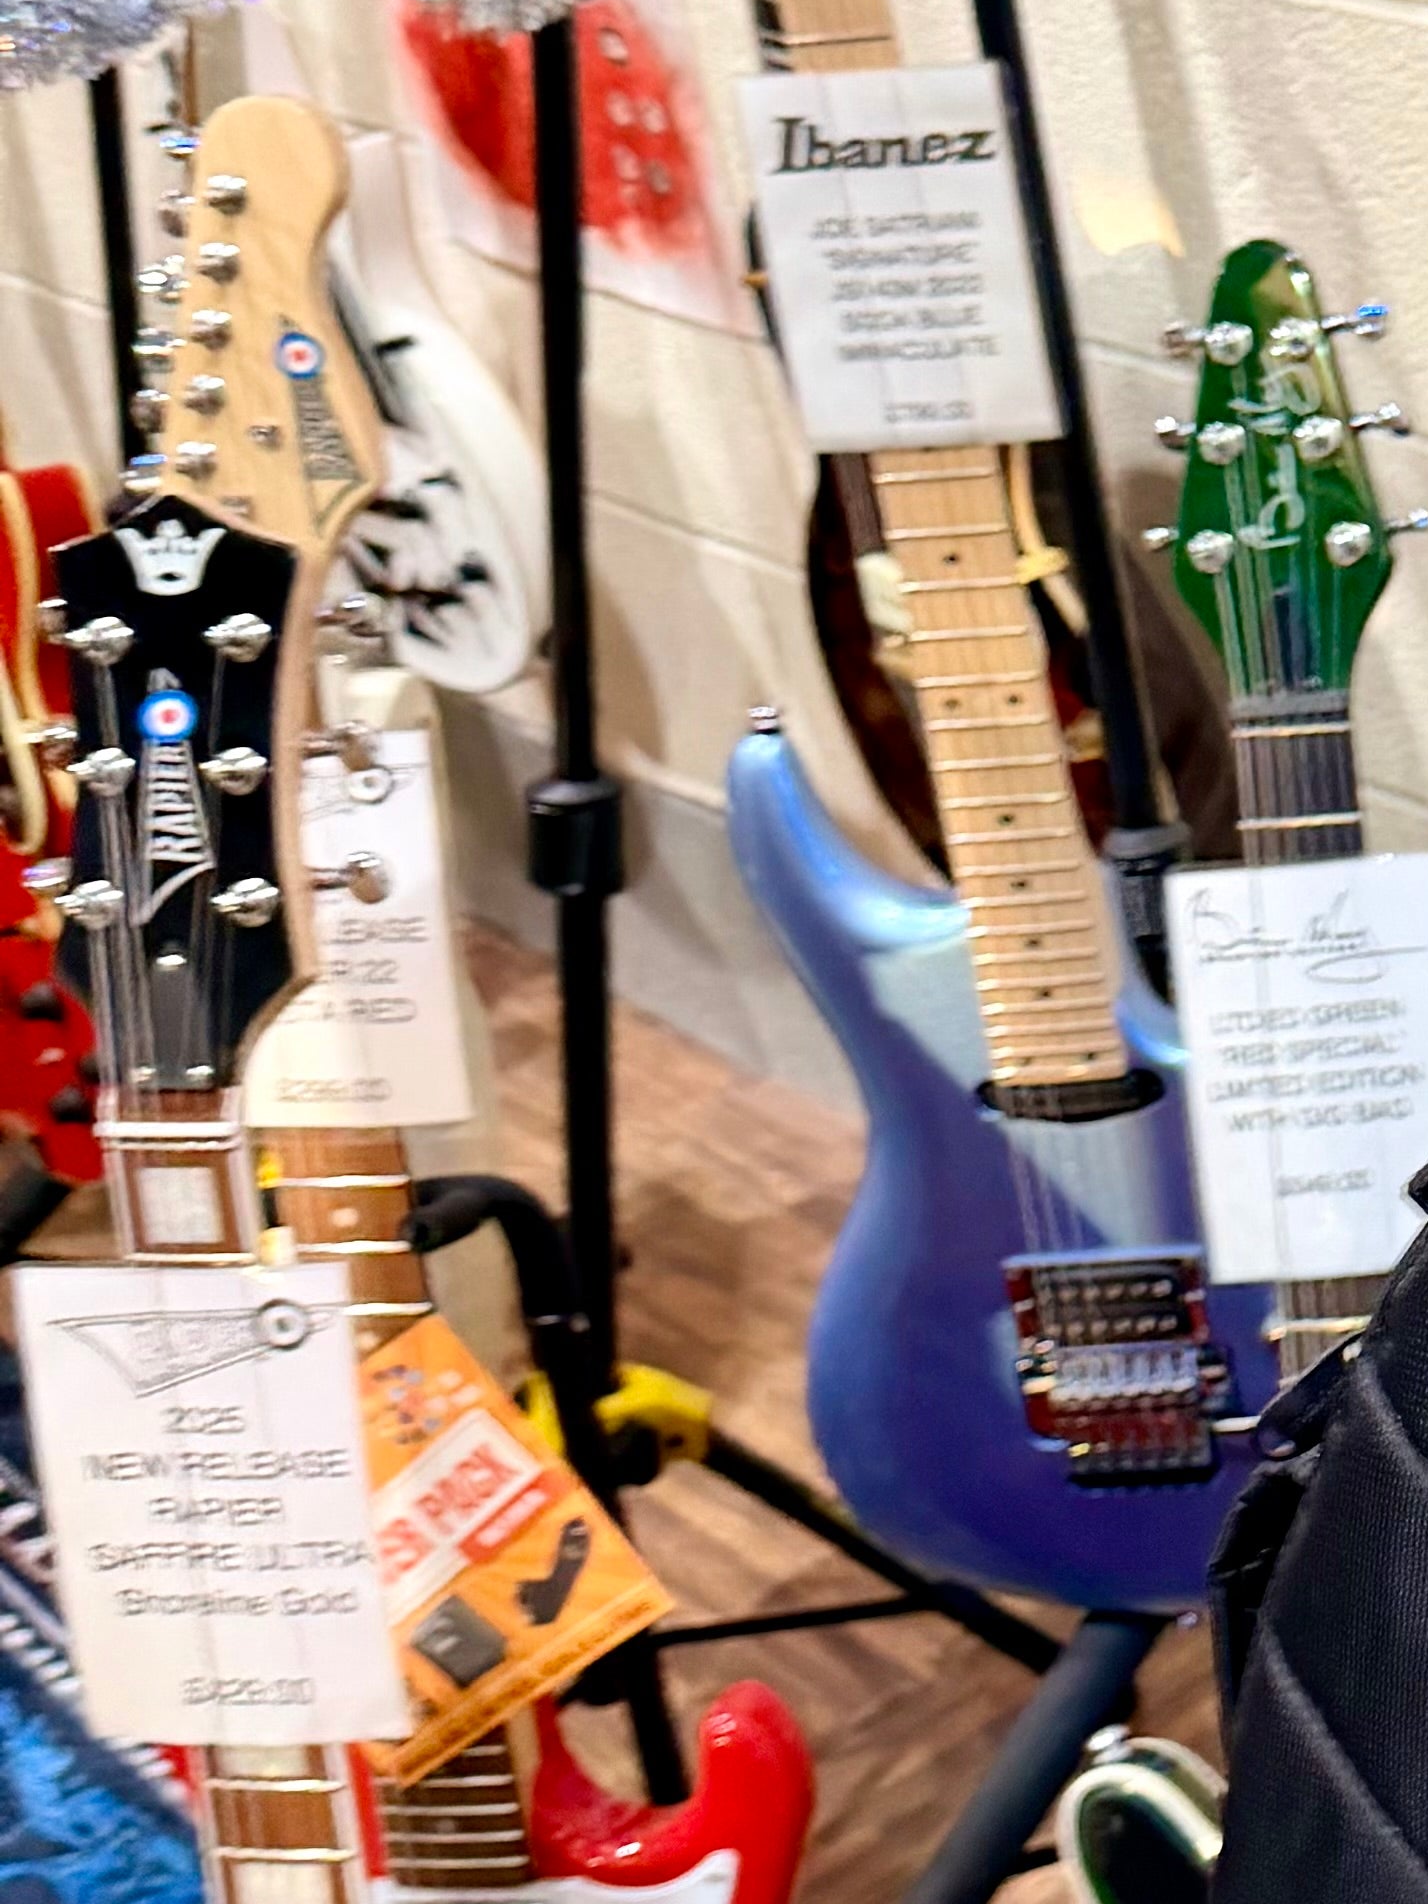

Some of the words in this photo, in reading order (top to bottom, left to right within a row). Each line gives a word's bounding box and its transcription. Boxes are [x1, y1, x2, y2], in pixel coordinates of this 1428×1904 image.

[772, 116, 996, 175] Ibanez
[148, 741, 210, 864] RAPIER
[161, 1405, 246, 1436] 2025
[177, 1447, 353, 1482] RELEASE
[147, 1496, 282, 1527] RAPIER
